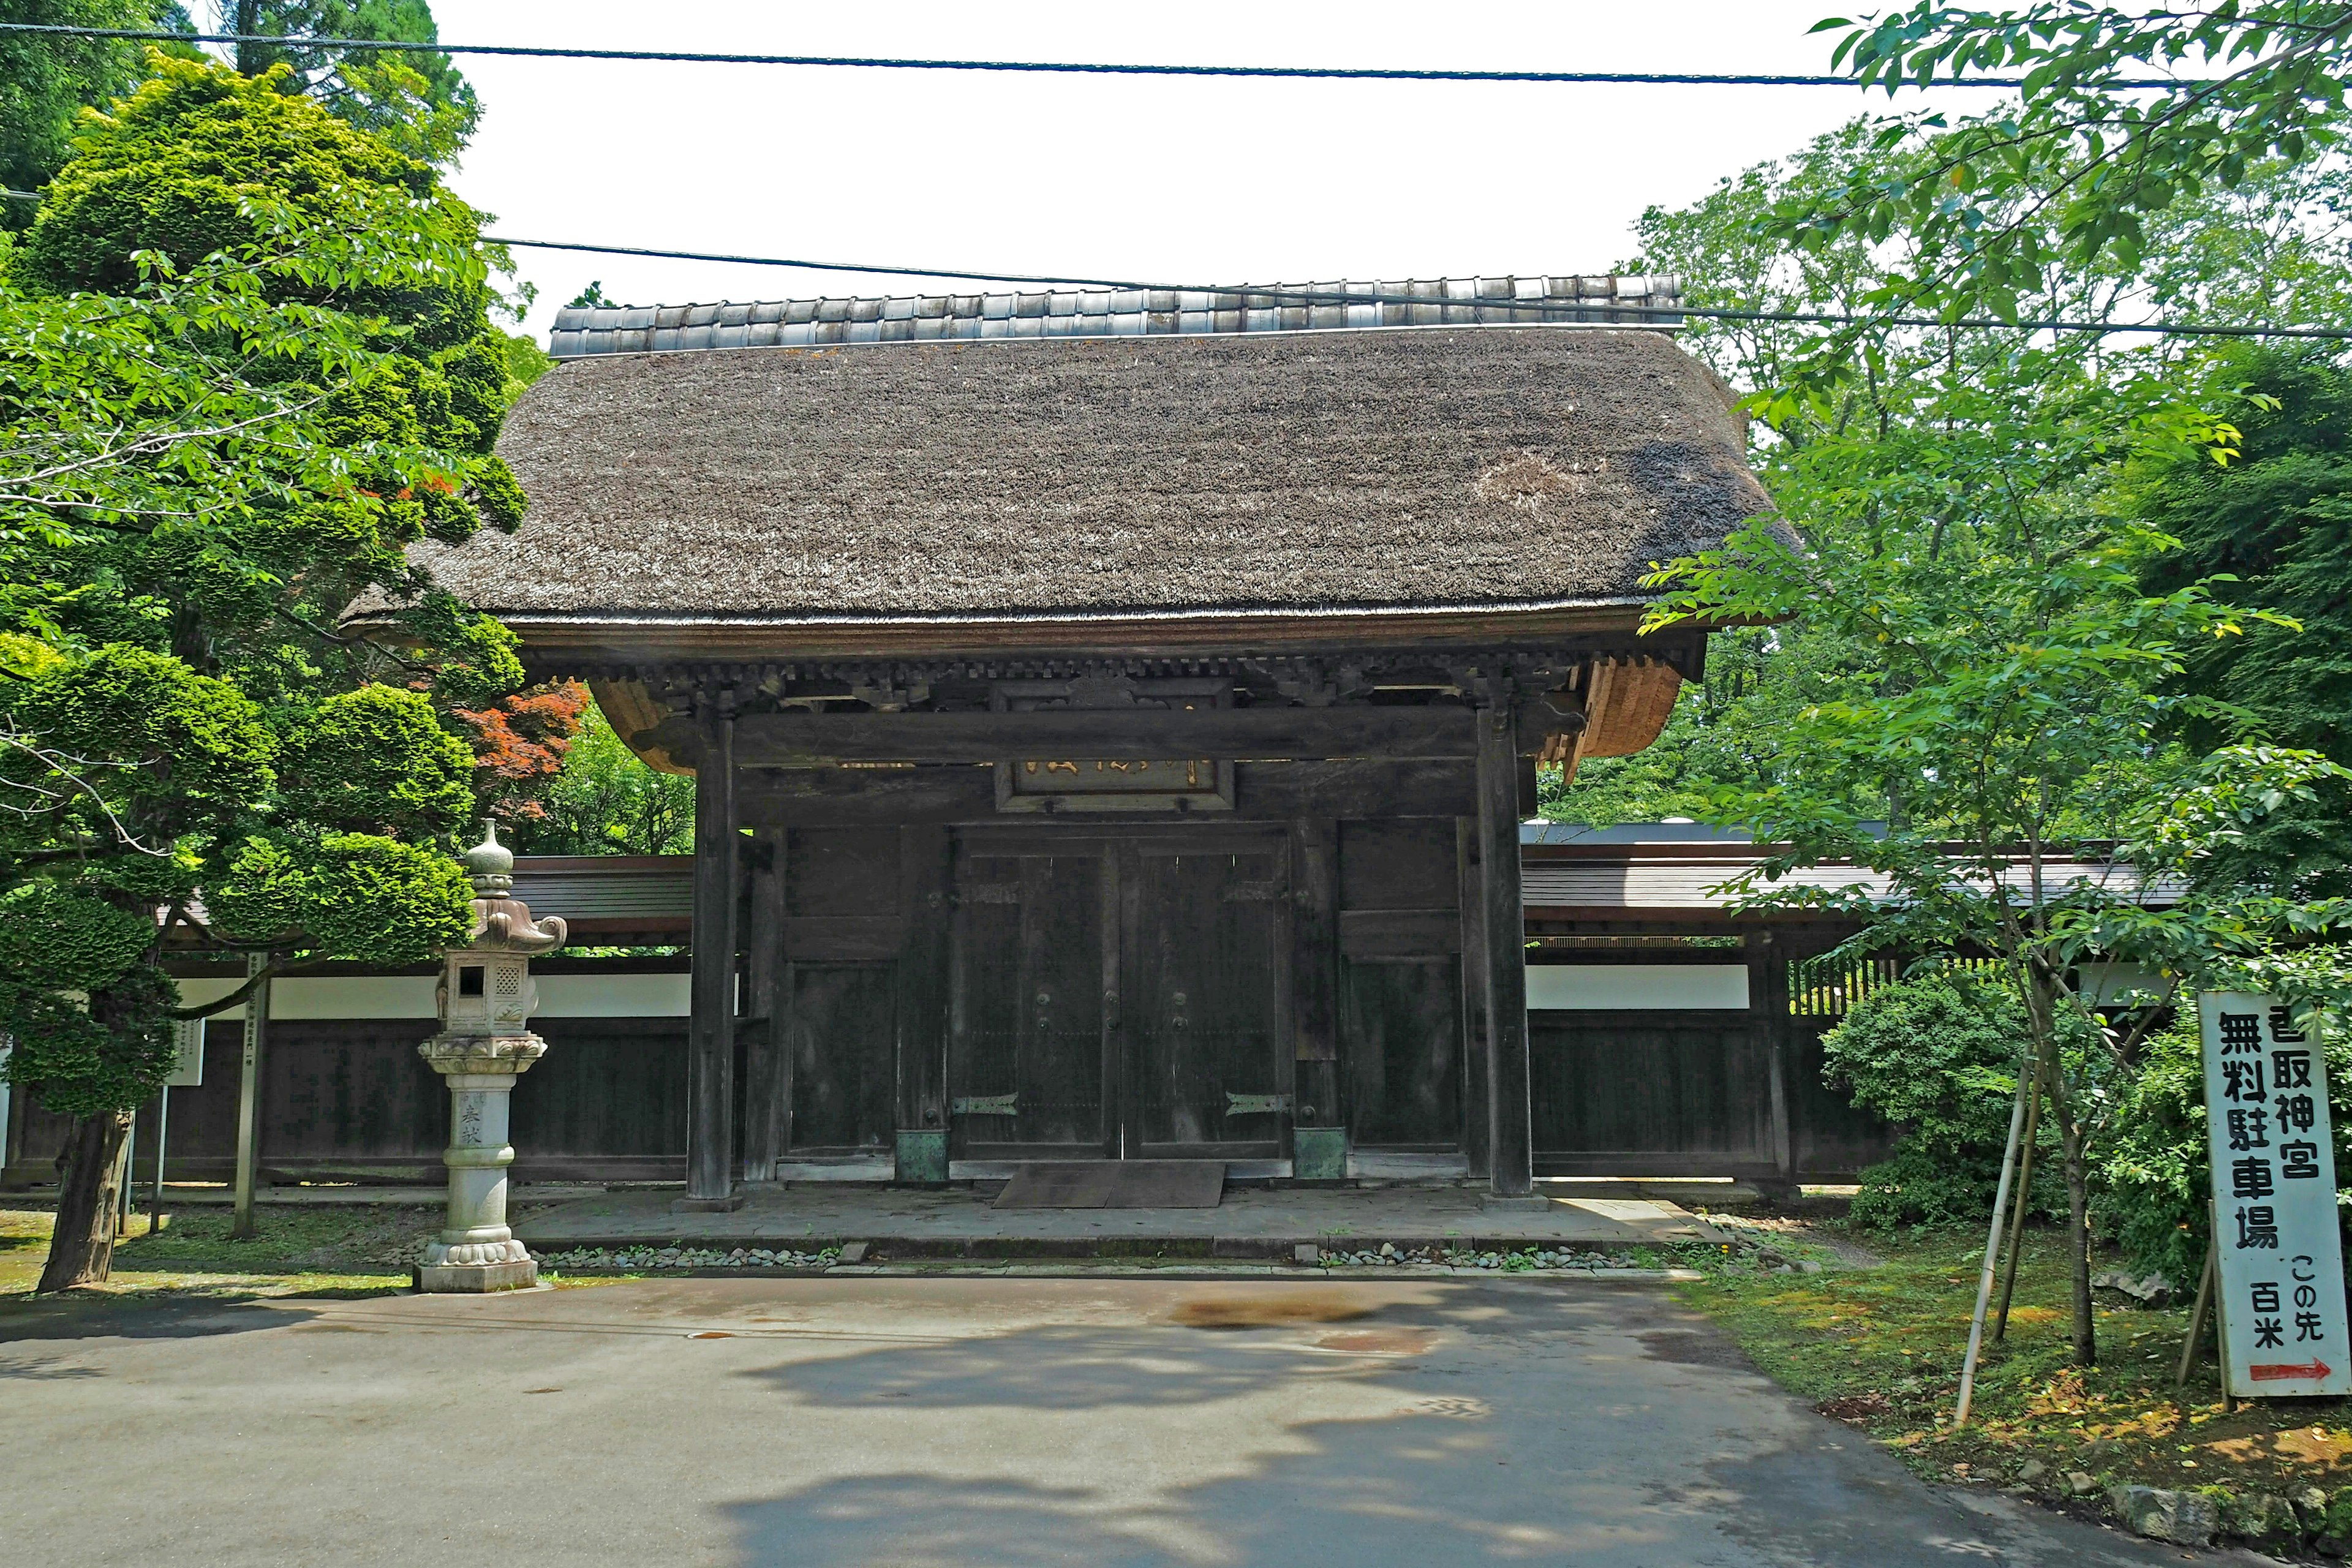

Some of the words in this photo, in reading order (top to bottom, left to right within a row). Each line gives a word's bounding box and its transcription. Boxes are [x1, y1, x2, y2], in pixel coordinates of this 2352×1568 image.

[2218, 1011, 2278, 1250] 無料駐車場
[2250, 1282, 2284, 1349] 百米
[2291, 1254, 2323, 1342] この先
